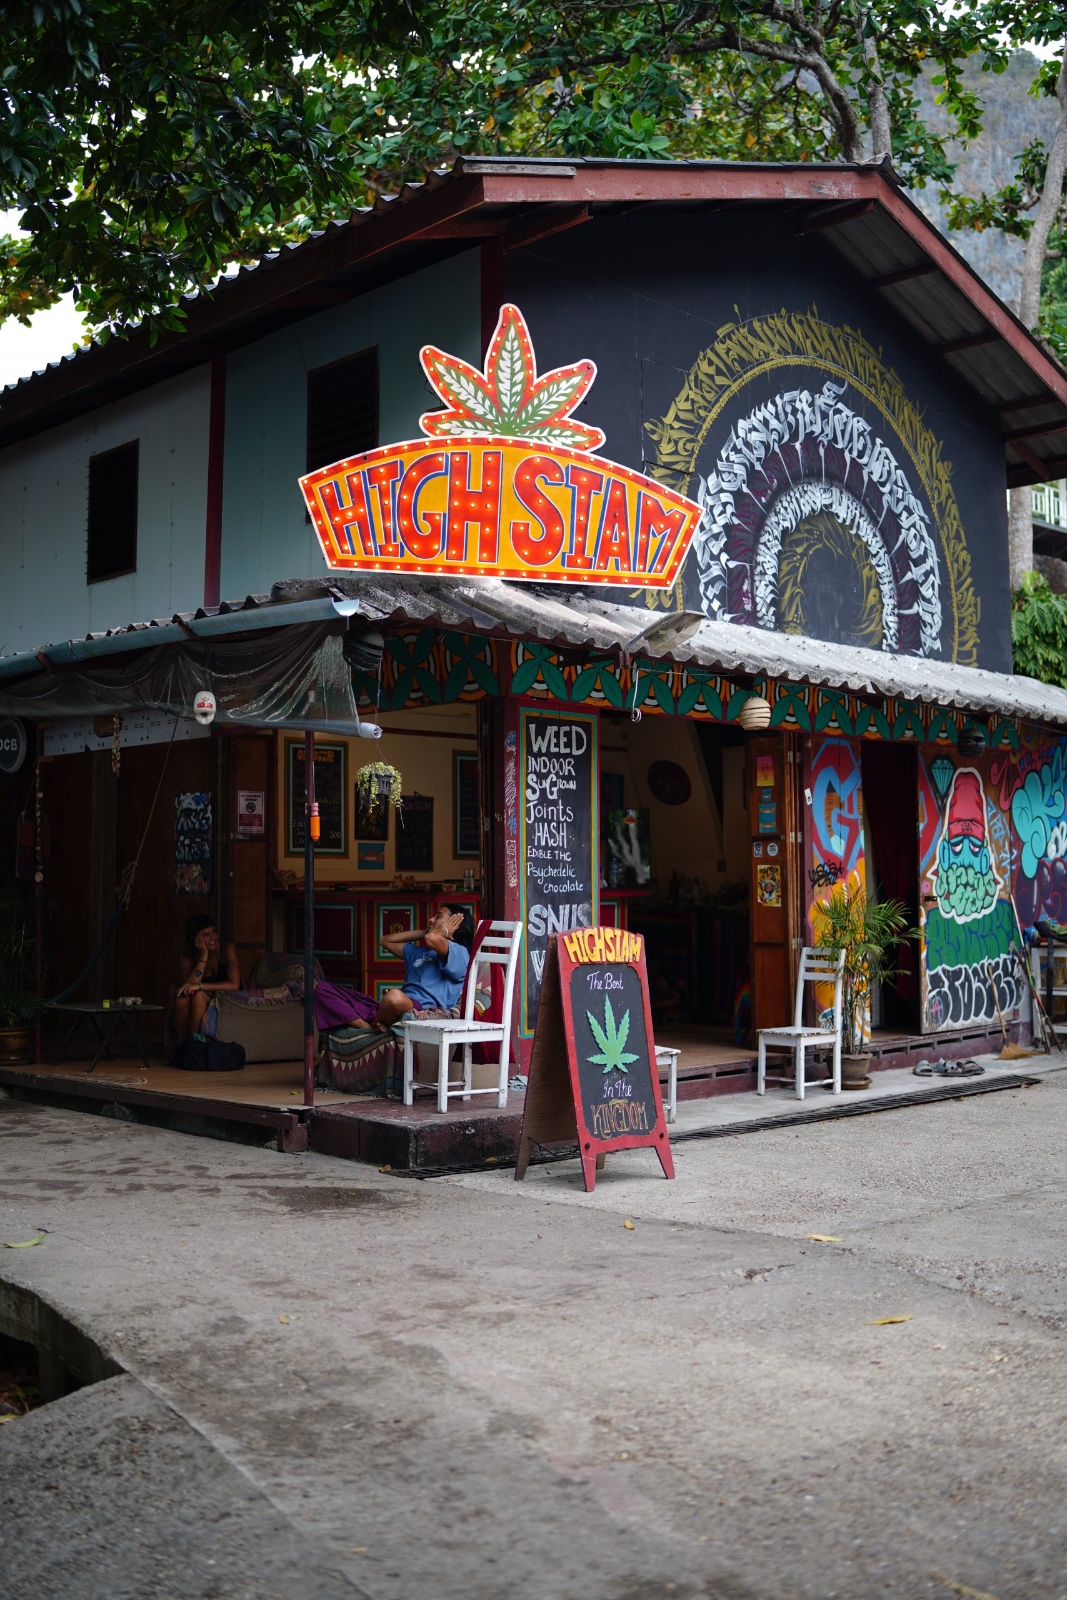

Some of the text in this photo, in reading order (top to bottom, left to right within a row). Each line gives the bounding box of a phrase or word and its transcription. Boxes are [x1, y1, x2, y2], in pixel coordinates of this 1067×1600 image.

[317, 451, 502, 563] HIGH
[511, 455, 690, 574] SIAM
[528, 723, 587, 755] WEED
[527, 755, 576, 776] INDOOR
[526, 799, 574, 824] Joints
[534, 822, 567, 849] HASH
[527, 845, 572, 862] EDIBLE THC
[526, 862, 576, 885] Psychedelic
[527, 903, 592, 936] SNUS
[586, 970, 624, 990] The Best
[602, 1079, 632, 1098] In The
[590, 1098, 649, 1140] KINGDOM
